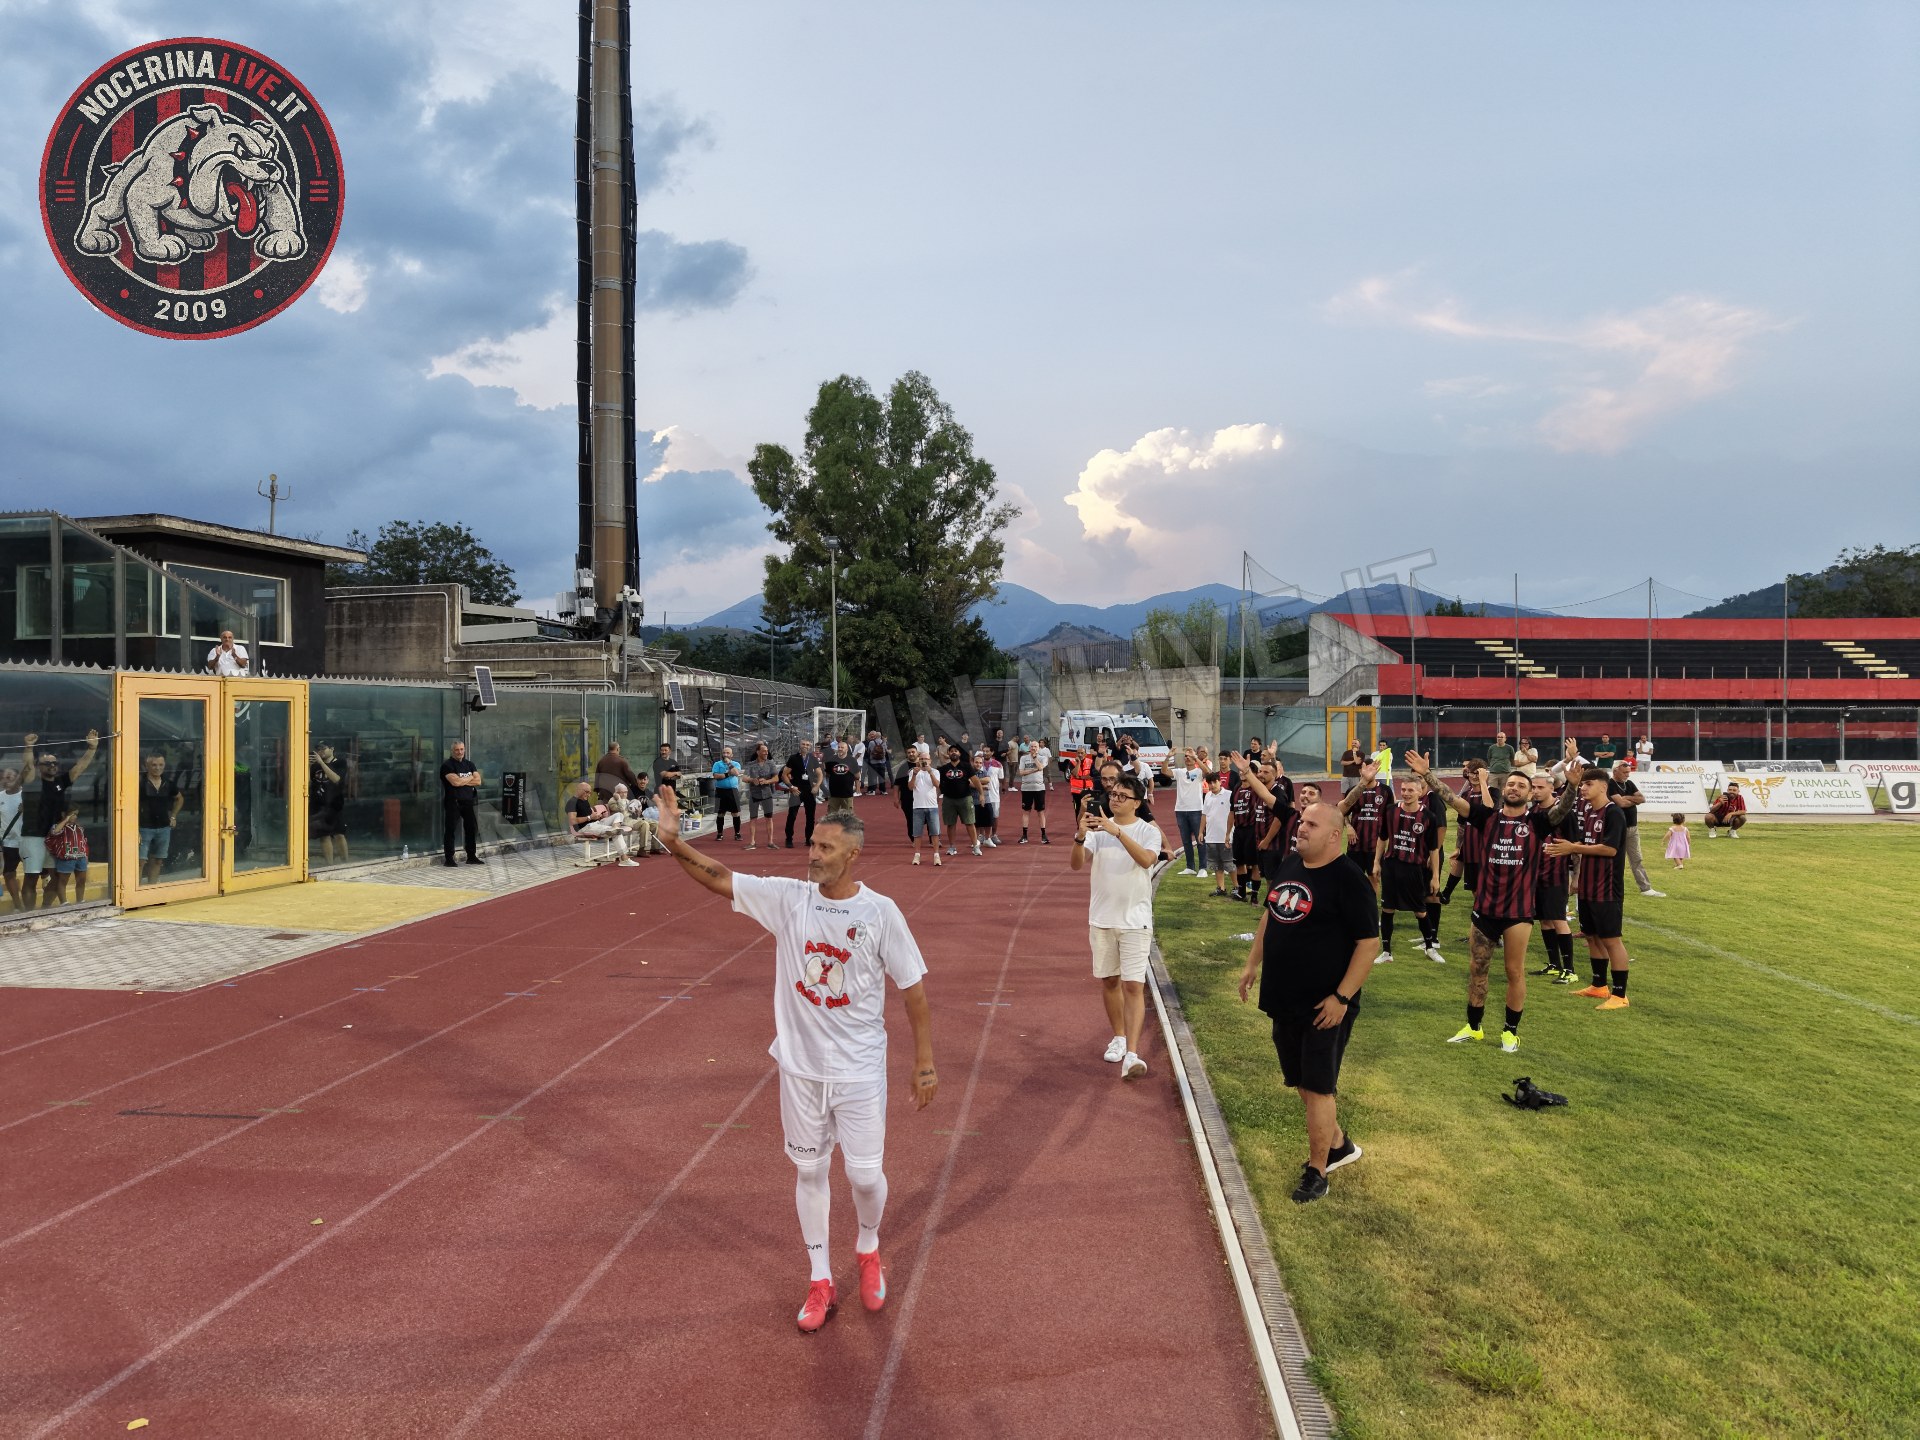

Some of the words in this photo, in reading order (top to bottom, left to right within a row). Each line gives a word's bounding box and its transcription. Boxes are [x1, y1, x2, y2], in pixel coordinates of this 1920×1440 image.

[1867, 764, 1920, 772] AUTORICAM
[1790, 778, 1852, 788] FARMACIA
[1794, 790, 1810, 799] DE
[1813, 790, 1862, 799] ANGELIS
[815, 904, 850, 915] GIVOVA
[805, 940, 852, 964] Angeli
